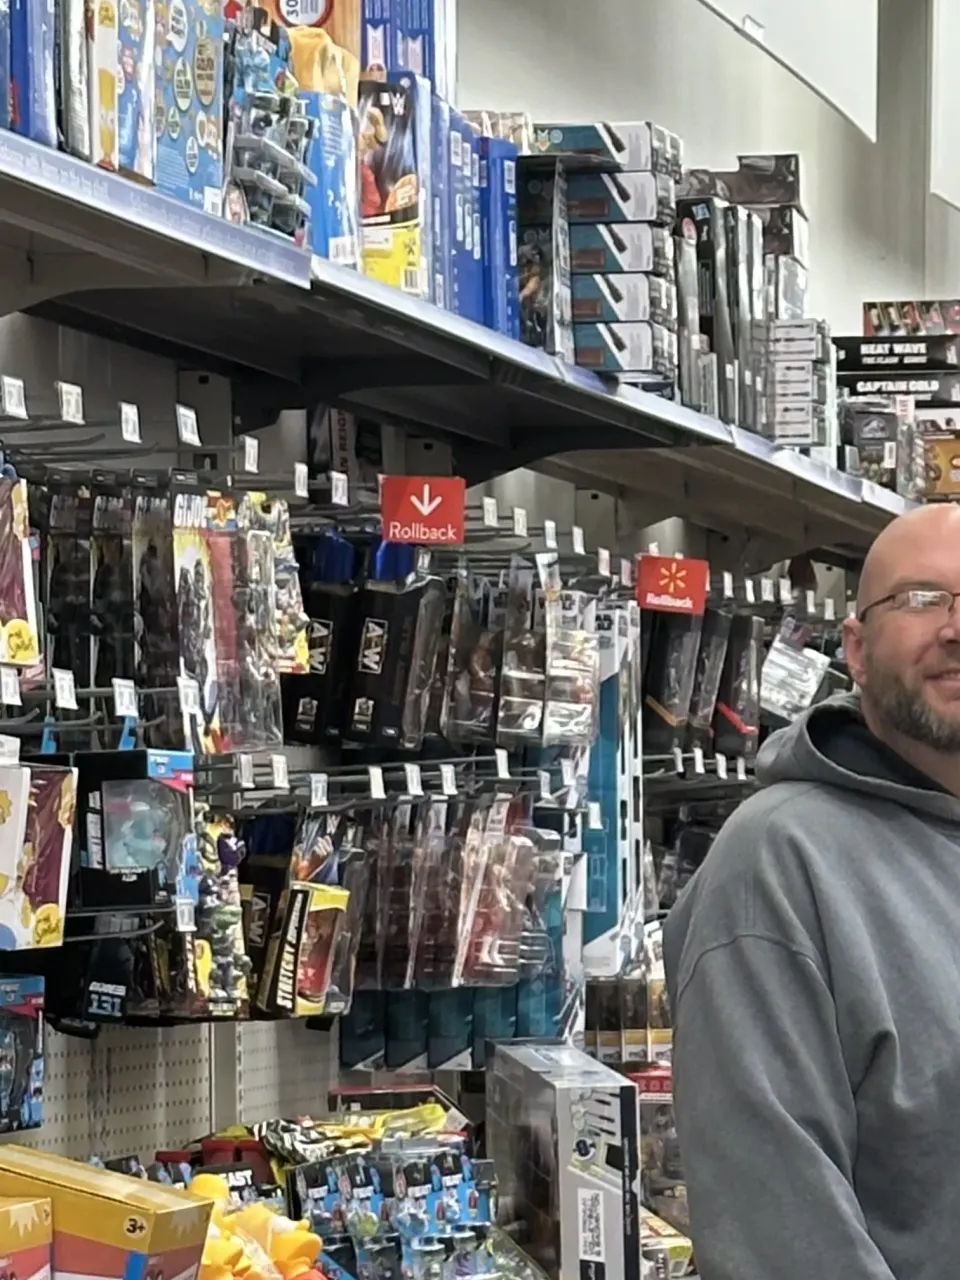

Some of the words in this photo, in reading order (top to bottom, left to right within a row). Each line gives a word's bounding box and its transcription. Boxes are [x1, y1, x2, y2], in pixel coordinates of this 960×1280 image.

[388, 521, 458, 541] Rollback
[276, 942, 297, 1009] STRETCHY
[126, 1217, 147, 1235] 3+
